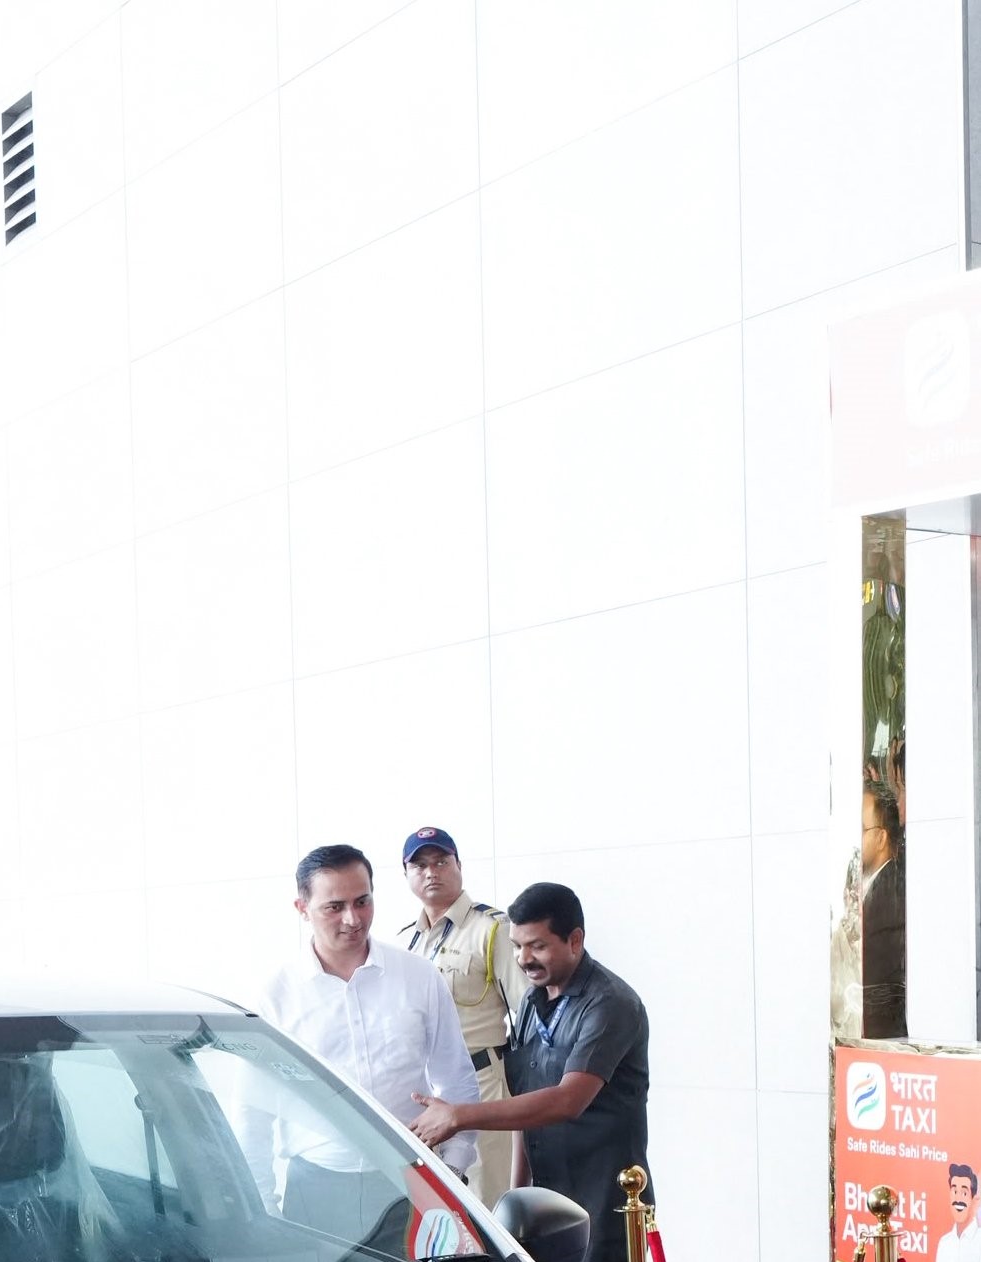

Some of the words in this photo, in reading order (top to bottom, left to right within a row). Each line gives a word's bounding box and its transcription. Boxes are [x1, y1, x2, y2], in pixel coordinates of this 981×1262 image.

[890, 1072, 938, 1103] भारत
[891, 1105, 937, 1135] TAXI
[847, 1137, 868, 1153] Safe
[870, 1140, 896, 1156] Rides
[898, 1143, 920, 1159] Sahi
[922, 1145, 948, 1162] Price
[844, 1182, 906, 1219] Bht
[909, 1191, 927, 1222] ki
